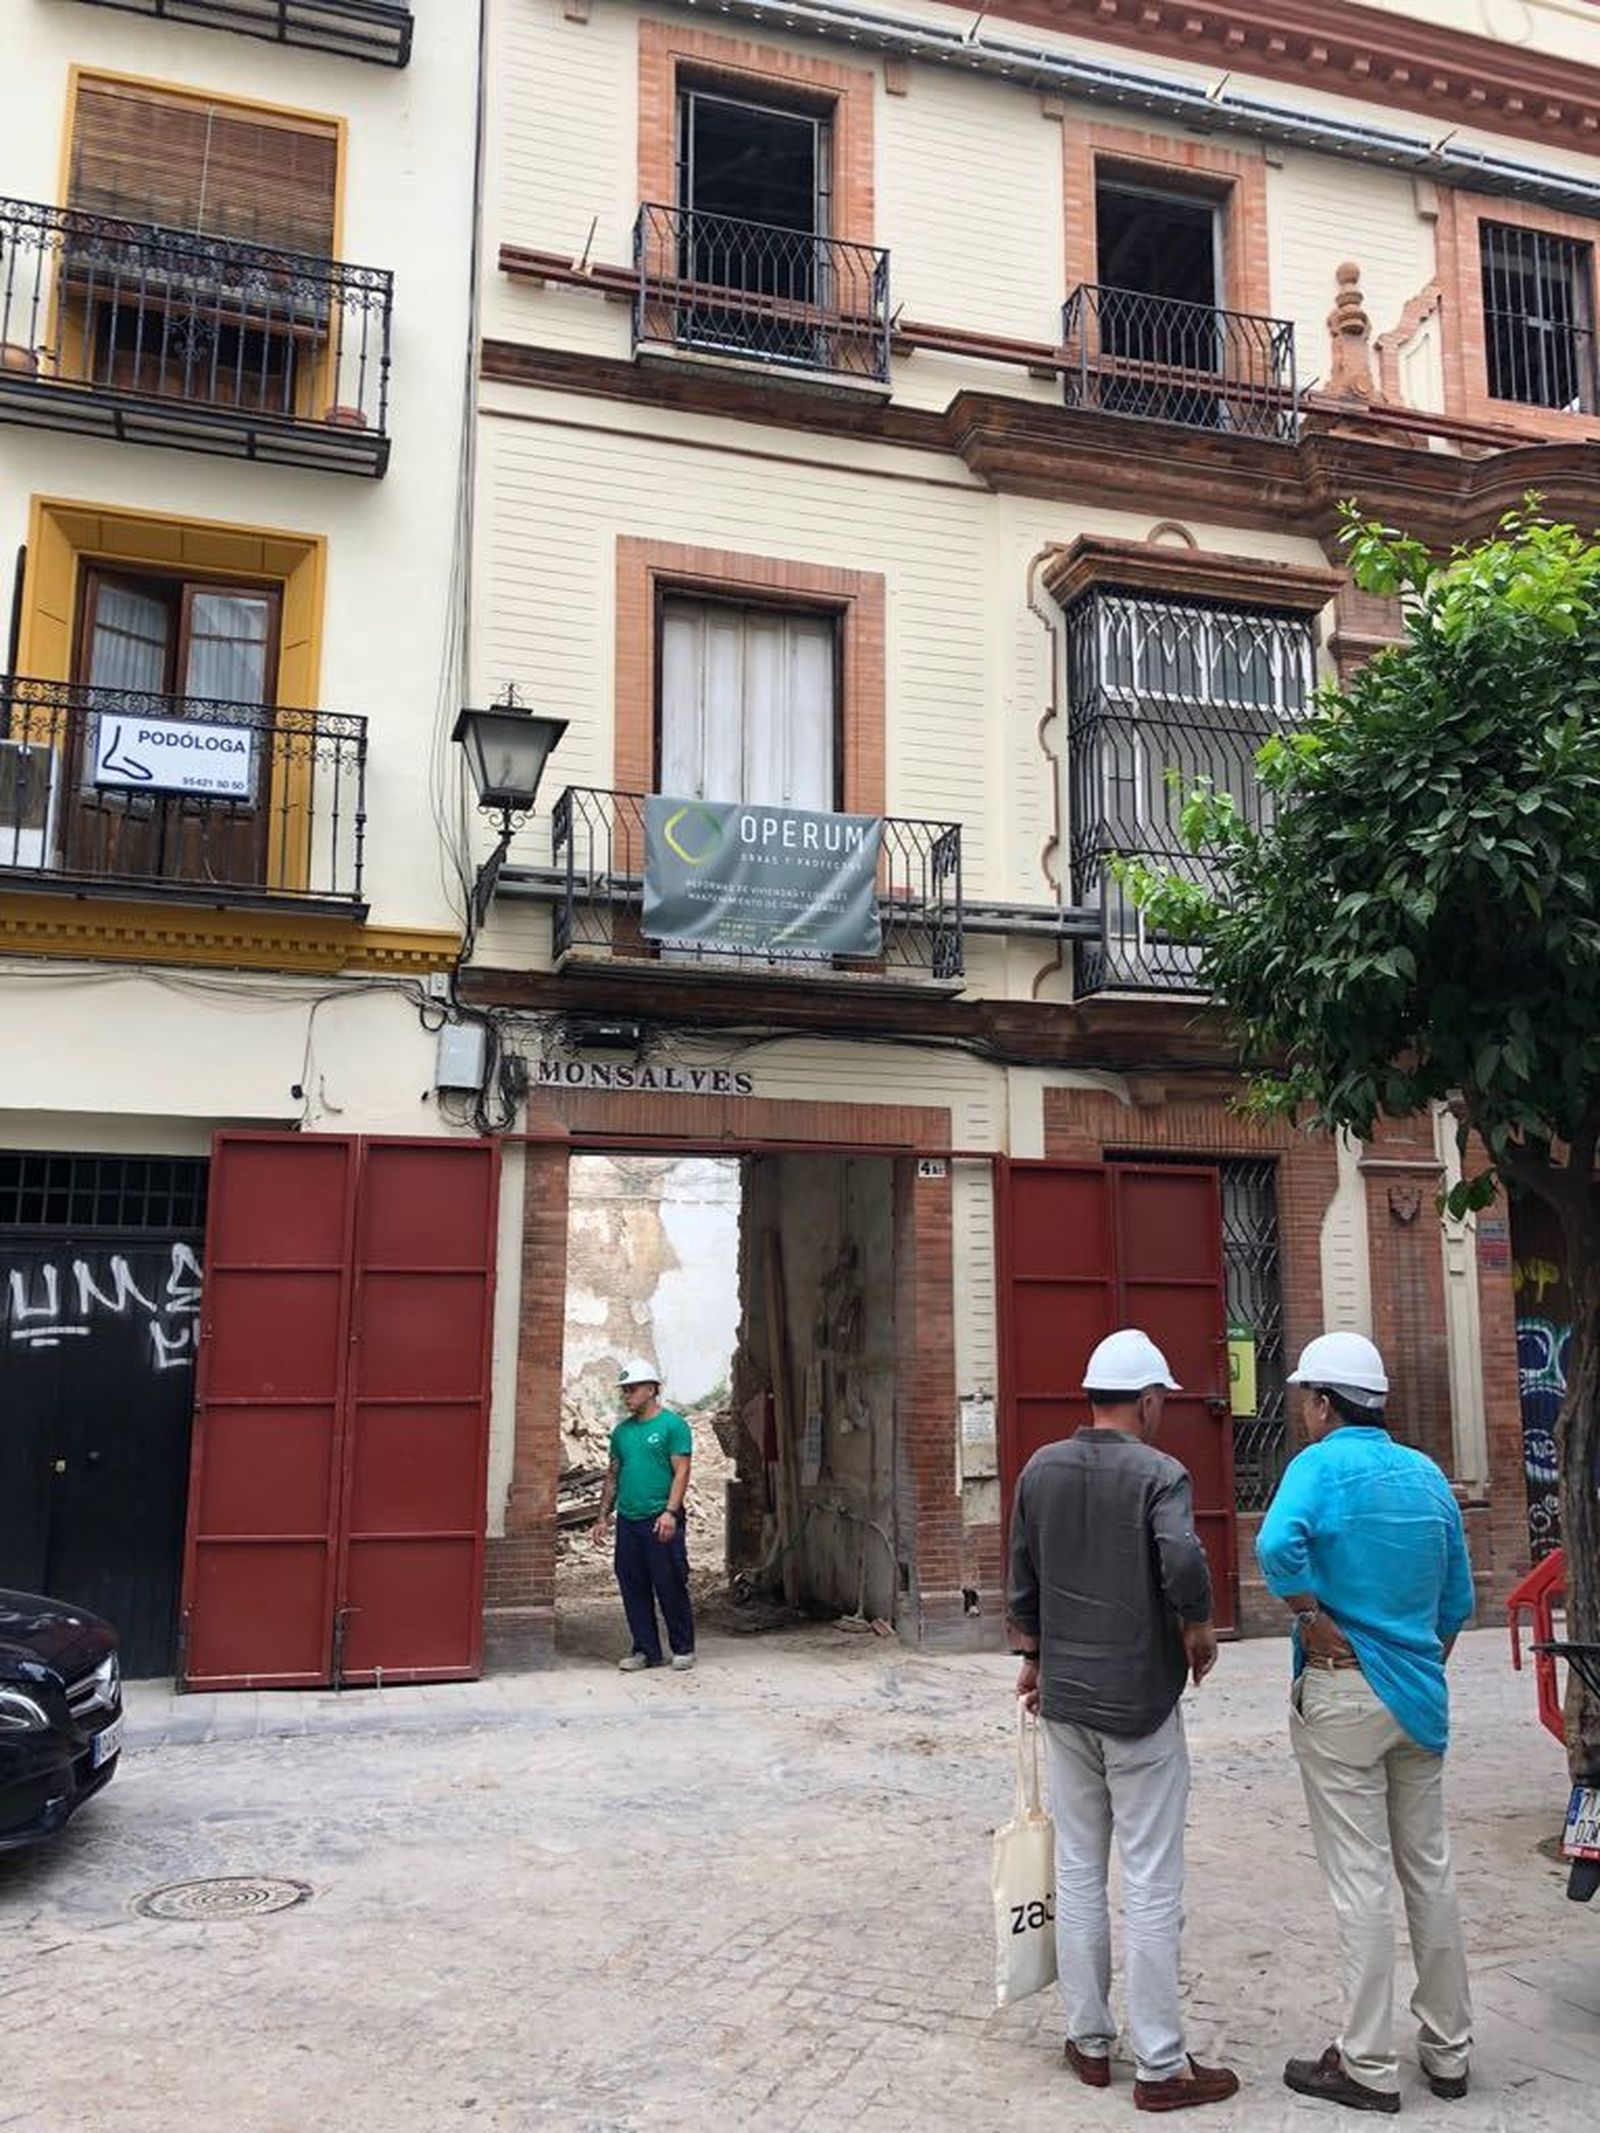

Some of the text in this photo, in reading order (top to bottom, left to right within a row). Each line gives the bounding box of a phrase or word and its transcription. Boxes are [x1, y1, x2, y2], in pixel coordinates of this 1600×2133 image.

[137, 729, 246, 754] PODÓLOGA
[741, 815, 864, 853] OPERUM
[538, 1061, 752, 1094] MONSALVES
